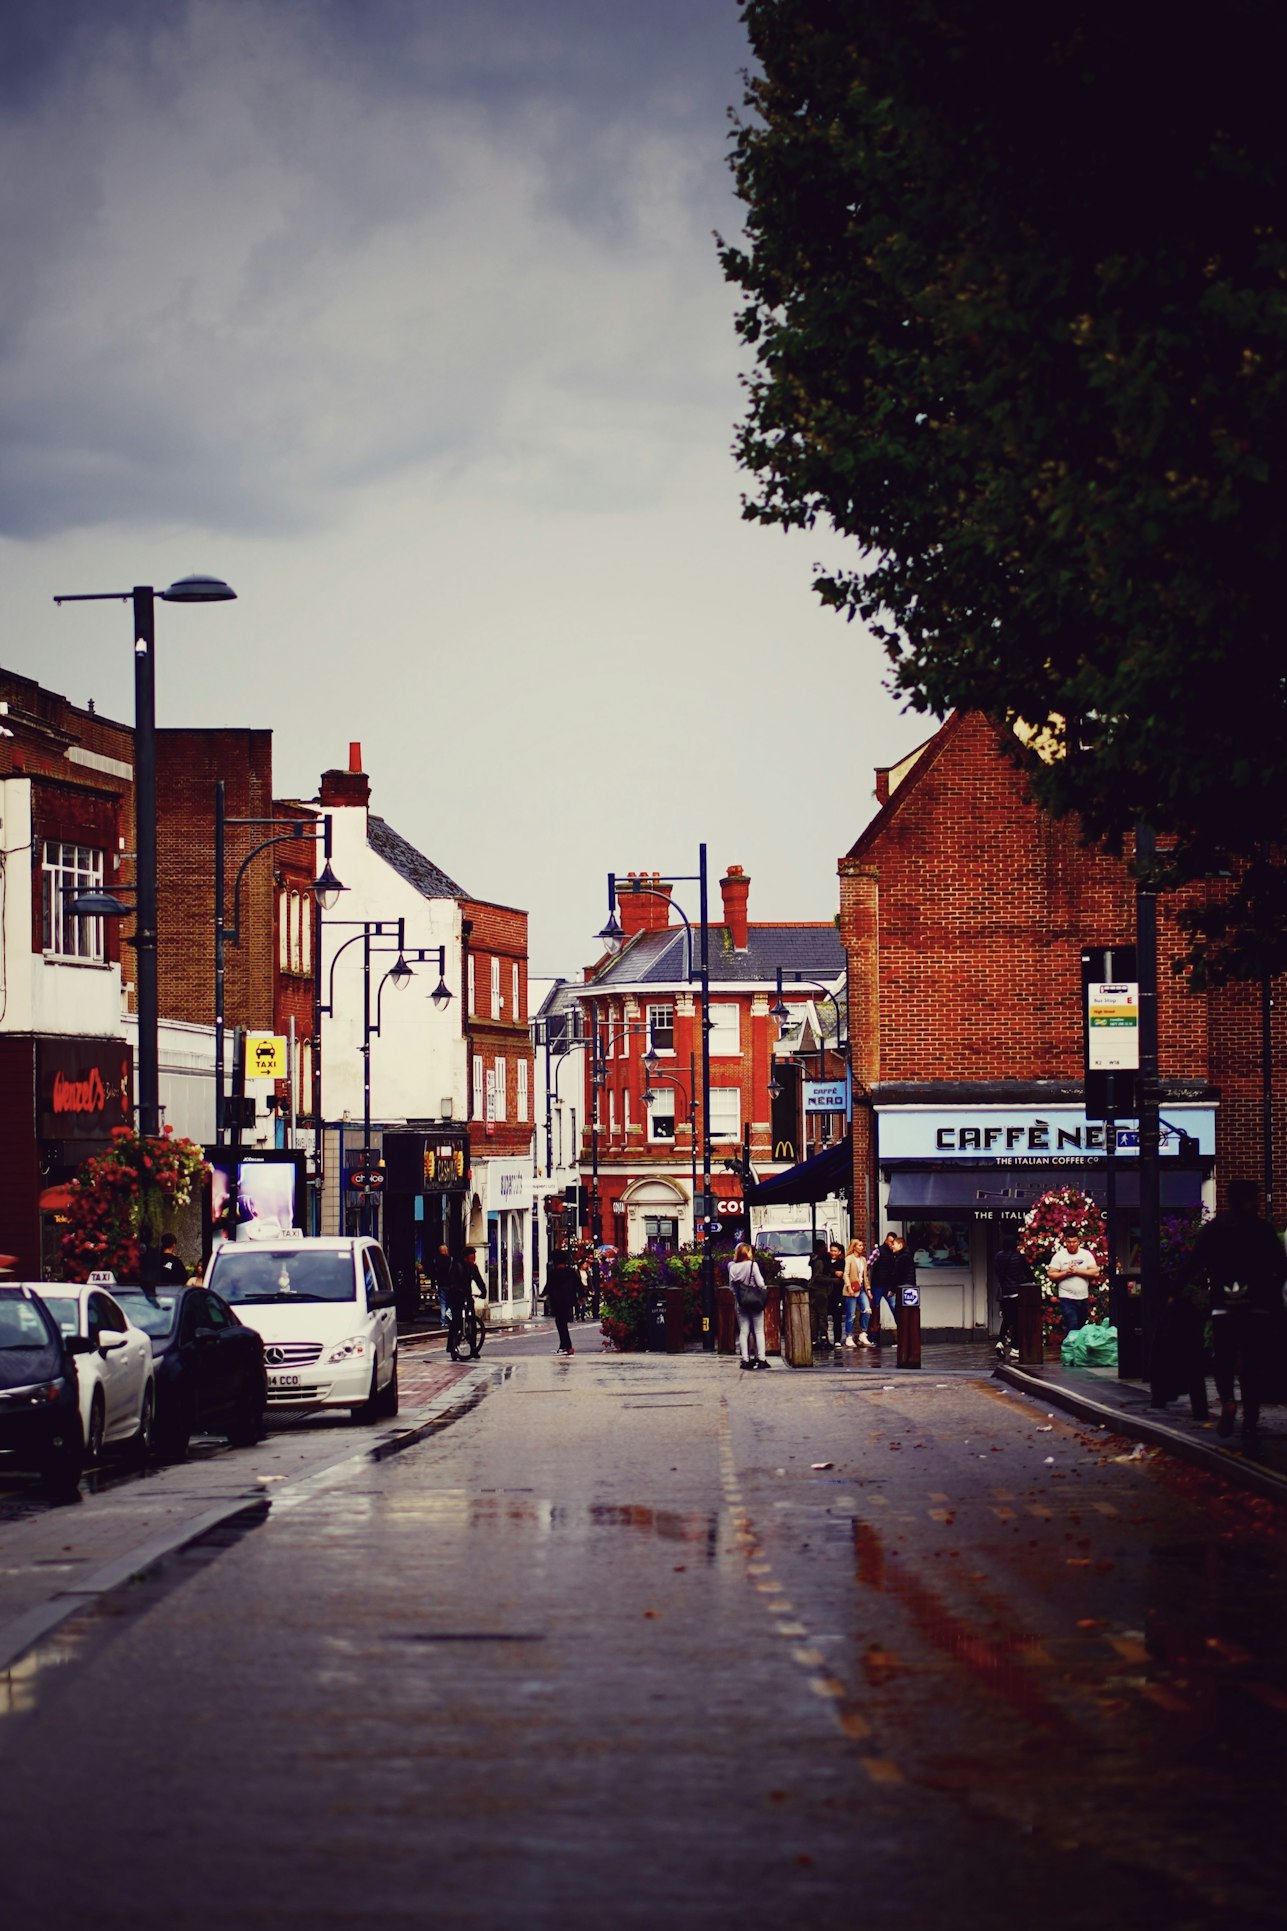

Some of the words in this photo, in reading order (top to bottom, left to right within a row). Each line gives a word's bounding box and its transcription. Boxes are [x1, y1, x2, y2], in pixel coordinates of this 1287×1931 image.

[1127, 996, 1133, 1004] E
[808, 1096, 843, 1105] NERO
[936, 1119, 1049, 1150] CAFFÈ
[995, 1157, 1012, 1165] THE
[1014, 1157, 1049, 1165] ITALIAN
[1051, 1157, 1085, 1165] COFFEE
[354, 1173, 385, 1183] chice
[974, 1211, 993, 1219] THE
[1001, 1211, 1026, 1219] ITALI
[281, 1230, 300, 1238] TAXI
[91, 1273, 111, 1281] TAXI
